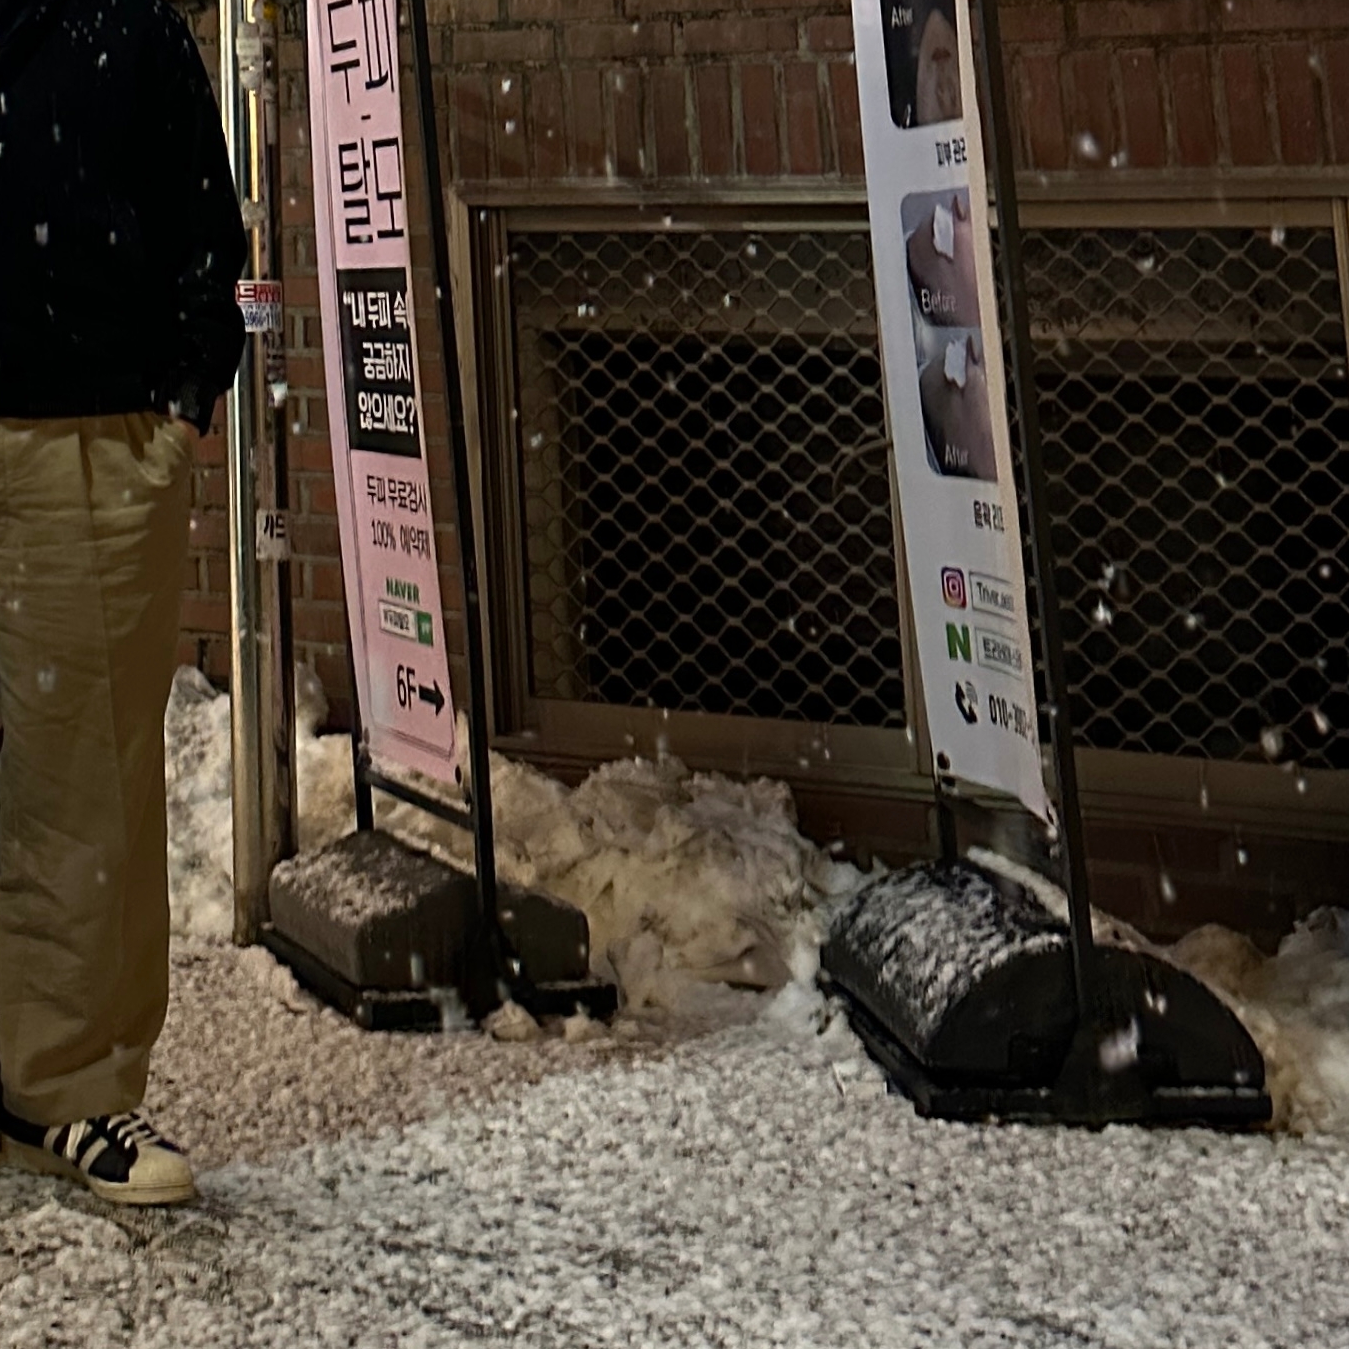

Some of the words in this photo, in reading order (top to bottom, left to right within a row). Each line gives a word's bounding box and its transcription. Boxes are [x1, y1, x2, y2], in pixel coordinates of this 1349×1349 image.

[338, 137, 404, 245] 탈모
[366, 290, 392, 329] 두피
[393, 290, 408, 330] 속
[362, 341, 411, 384] 궁금하지
[366, 474, 387, 508] 두피
[371, 518, 397, 551] 100%
[399, 523, 432, 561] 예약제
[385, 576, 420, 605] NAVER
[396, 663, 416, 712] 6F
